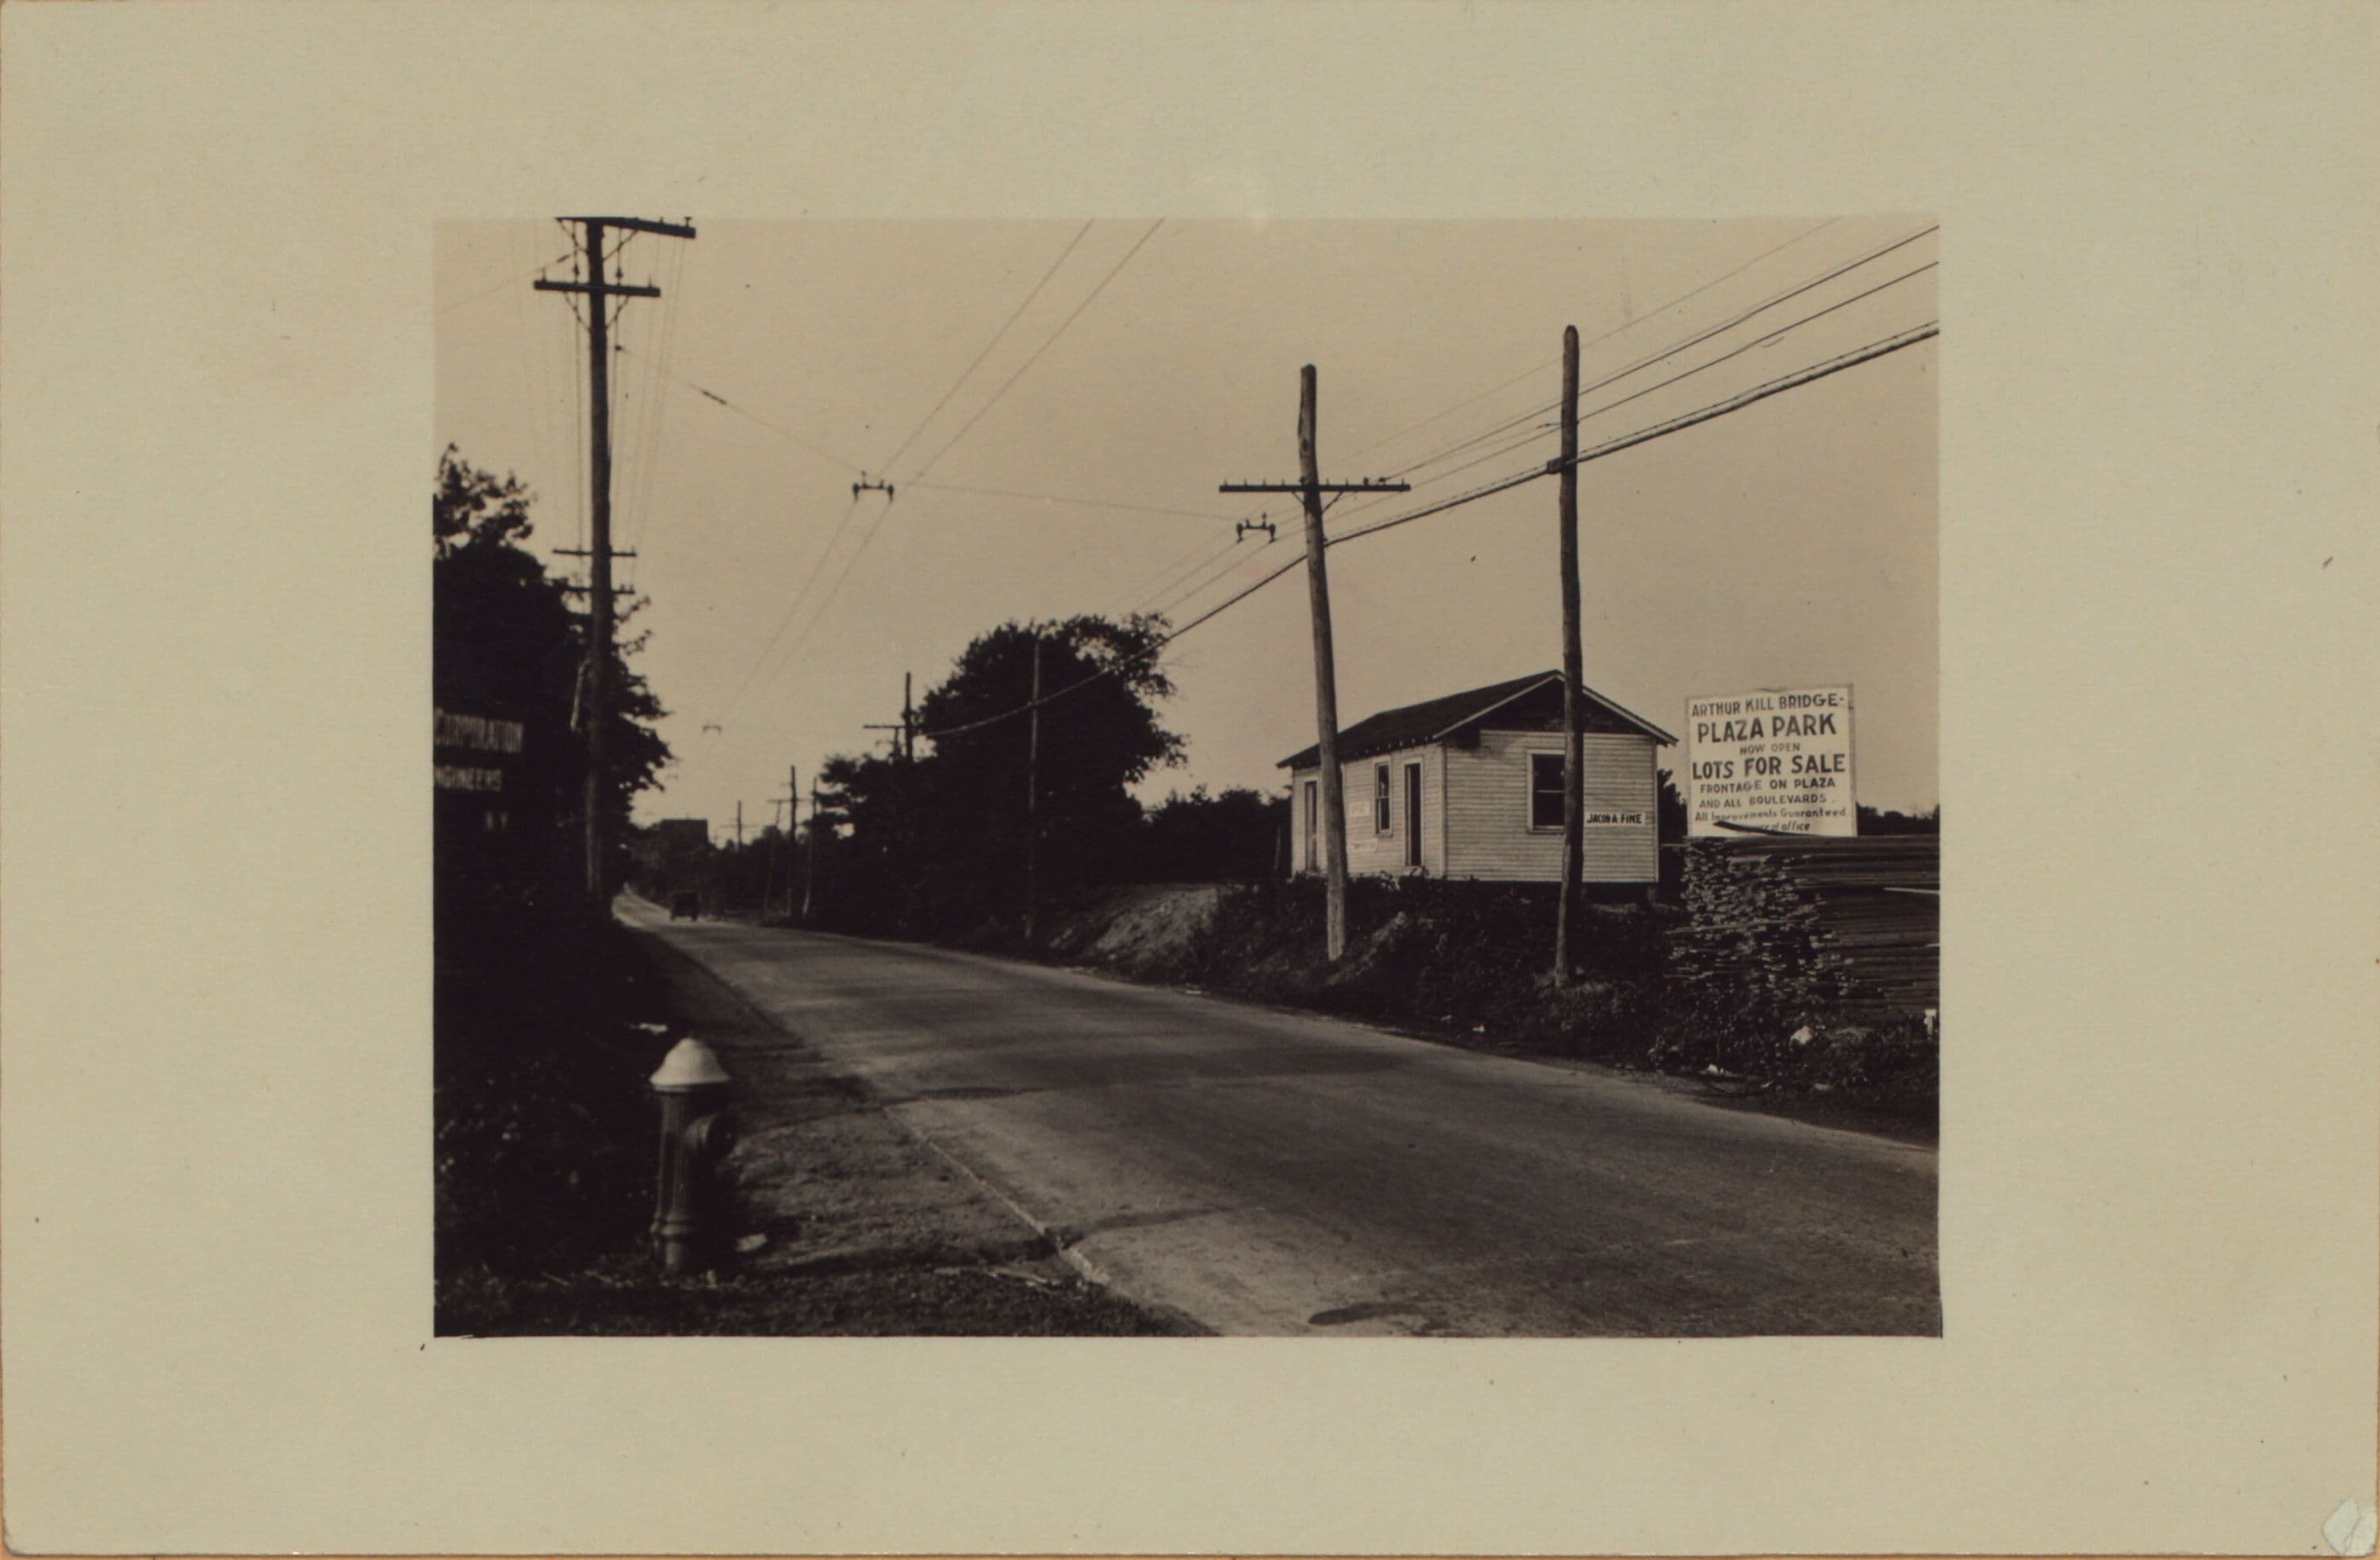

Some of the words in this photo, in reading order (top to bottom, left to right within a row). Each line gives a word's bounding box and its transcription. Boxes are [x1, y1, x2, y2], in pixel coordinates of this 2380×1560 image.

[1692, 701, 1741, 717] ARTHUR
[1746, 697, 1774, 712] KILL
[1697, 718, 1764, 743] PLAZA
[1772, 713, 1837, 738] PARK
[1740, 744, 1765, 755] NOW
[1771, 742, 1800, 753] OPEN
[1692, 761, 1734, 780] LOTS
[1745, 756, 1781, 776] FOR
[1791, 754, 1846, 774] SALE
[1700, 780, 1763, 793] FRONTAGE
[1769, 779, 1787, 790] ON
[1794, 777, 1836, 790] PLAZA
[1700, 798, 1720, 809] AND
[1723, 798, 1742, 808] ALL
[1620, 813, 1642, 824] FINE
[1695, 811, 1708, 822] All
[1711, 807, 1777, 822] Improvements
[1780, 807, 1846, 818] Guaranteed
[1781, 820, 1811, 831] office
